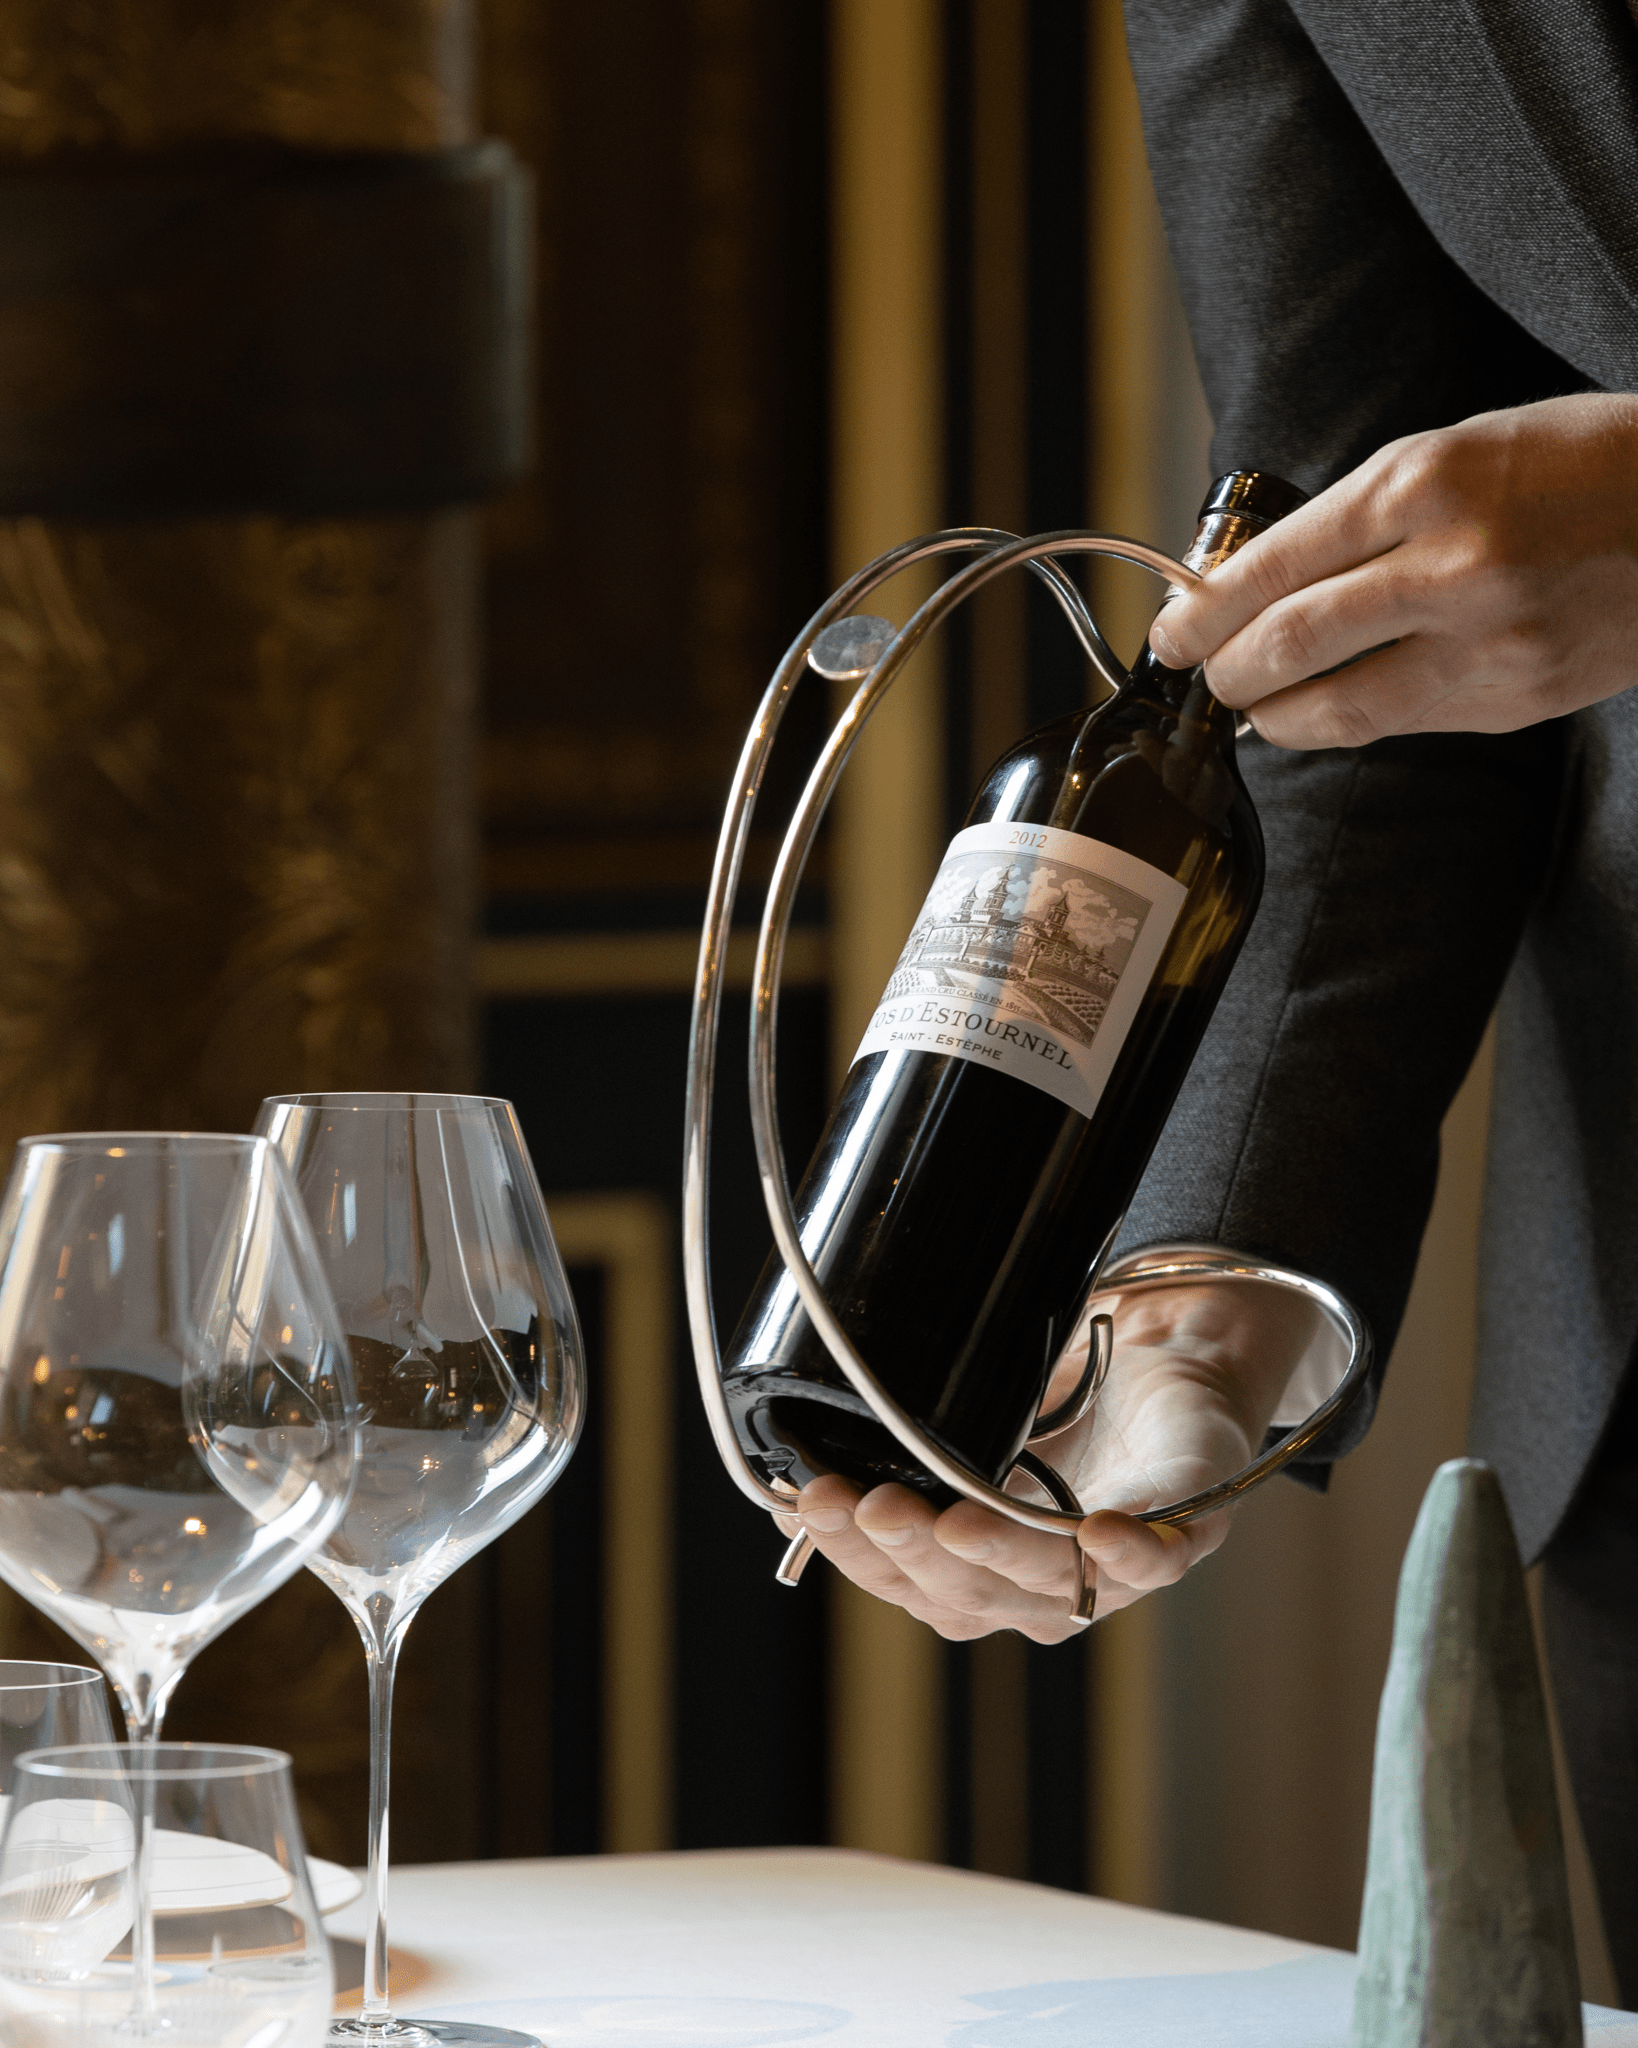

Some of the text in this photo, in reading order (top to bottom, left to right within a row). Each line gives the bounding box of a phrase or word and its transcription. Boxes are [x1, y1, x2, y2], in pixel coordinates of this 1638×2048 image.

[1009, 830, 1048, 849] 2012
[910, 986, 937, 994] GRAND
[956, 988, 988, 1001] CLASSÉ
[990, 996, 1003, 1006] EN
[889, 1031, 925, 1041] SAINT
[935, 1034, 1003, 1060] ESTÈPHE
